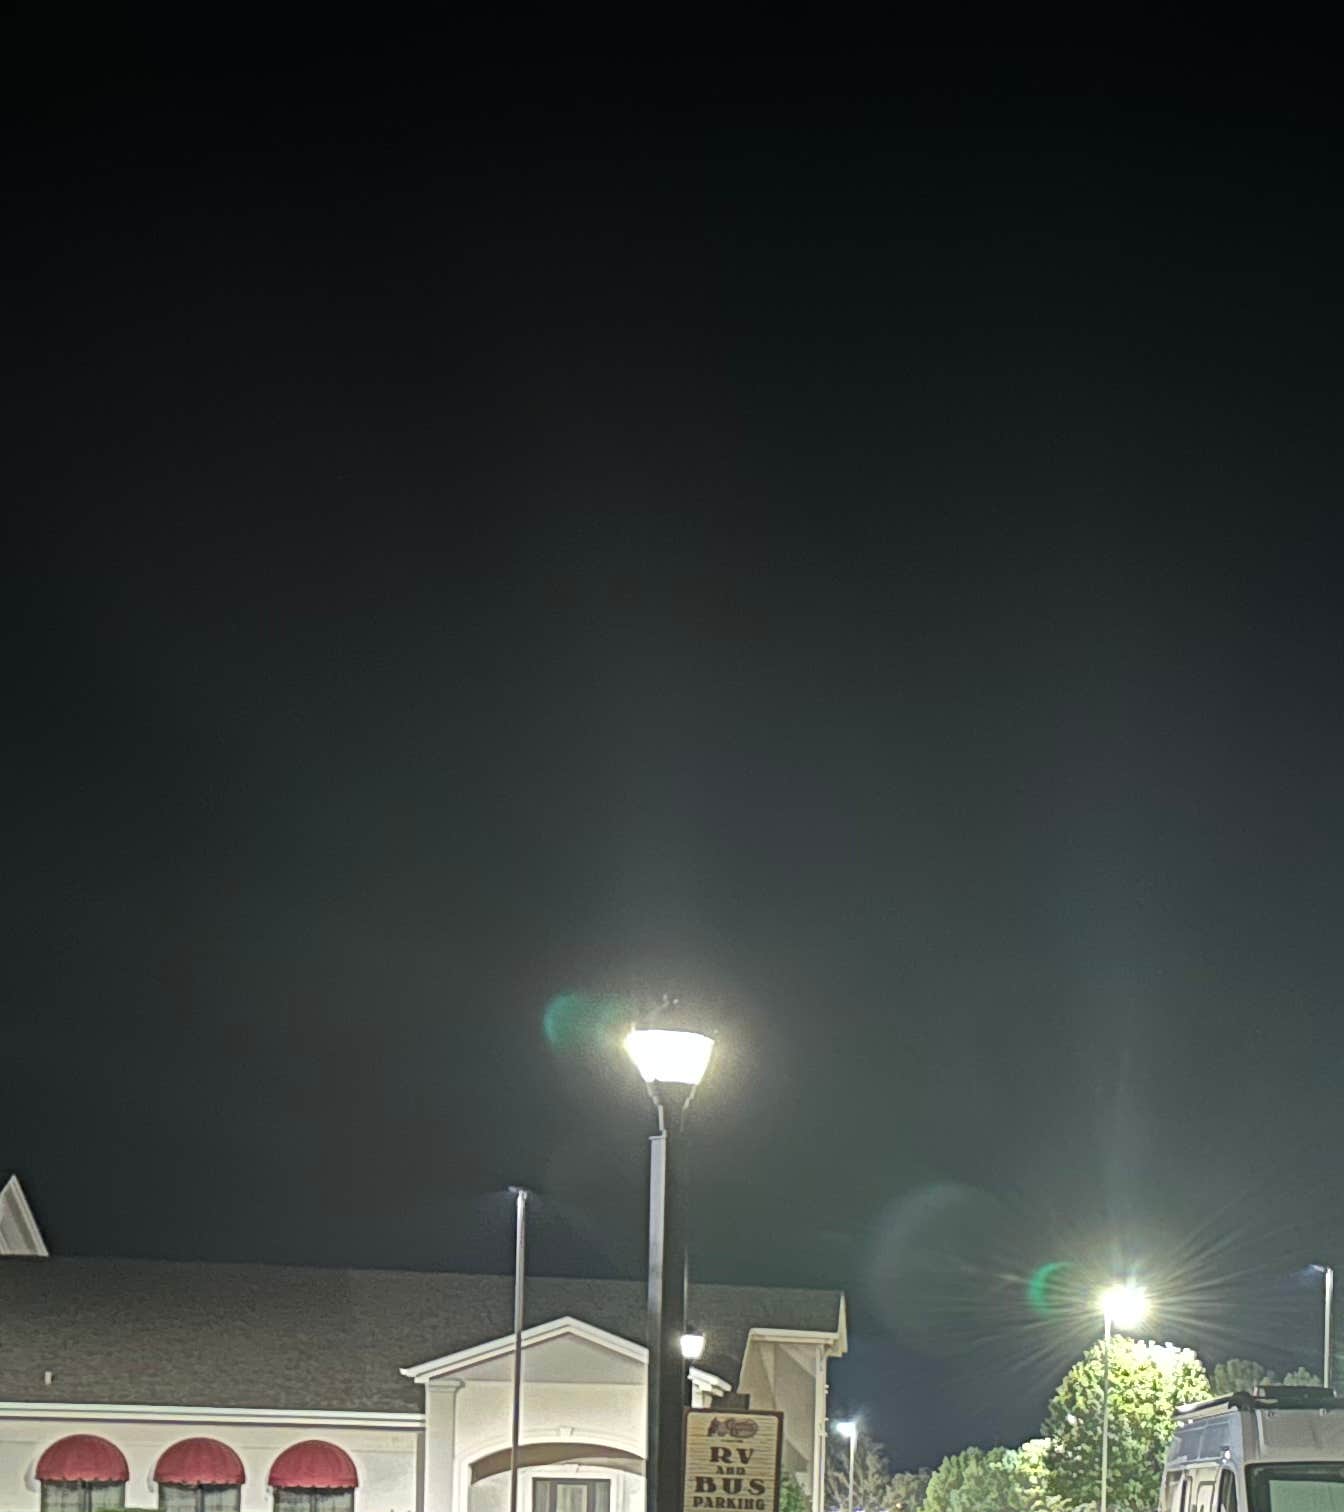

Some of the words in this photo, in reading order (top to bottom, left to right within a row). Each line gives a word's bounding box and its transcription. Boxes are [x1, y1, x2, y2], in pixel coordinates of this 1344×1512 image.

[710, 1446, 754, 1465] RV
[715, 1466, 746, 1475] AND
[694, 1476, 766, 1496] BUS
[693, 1496, 766, 1510] PARKING
